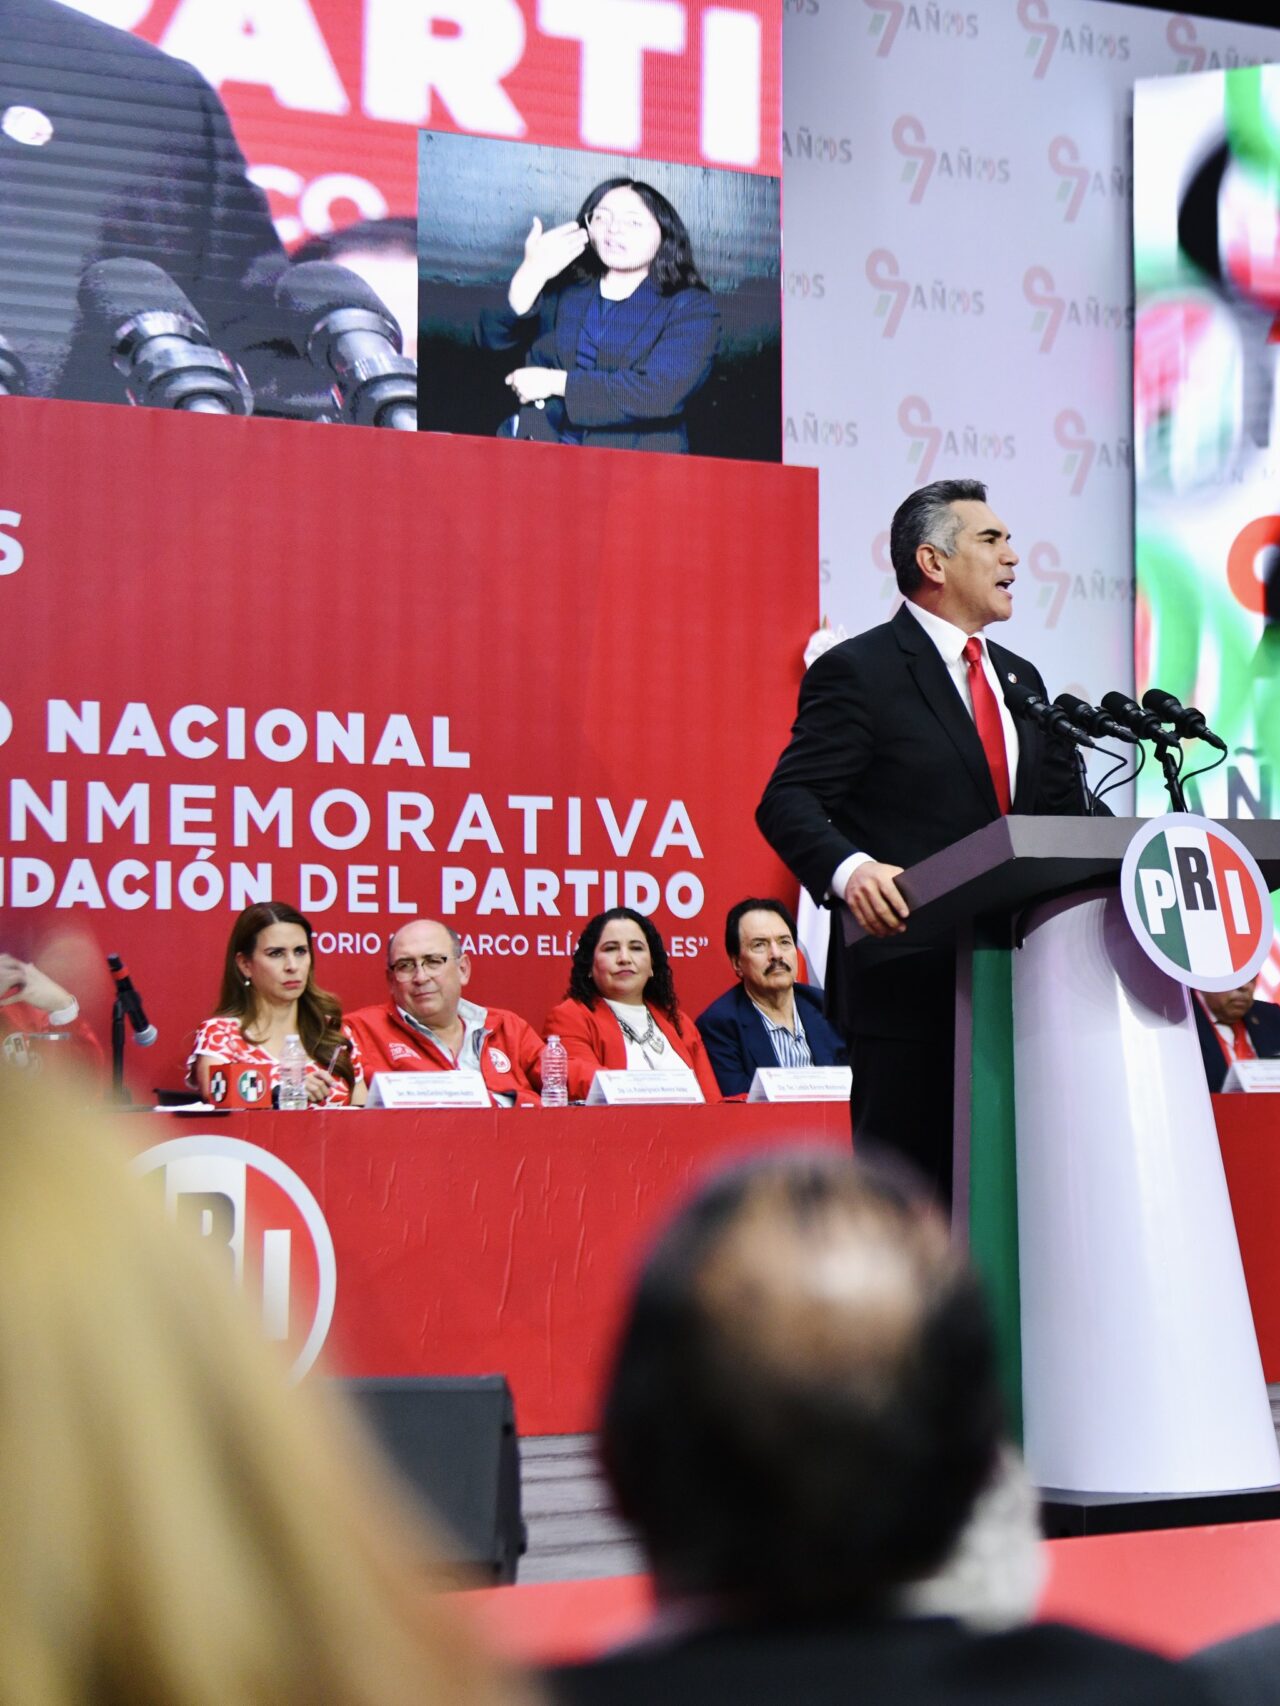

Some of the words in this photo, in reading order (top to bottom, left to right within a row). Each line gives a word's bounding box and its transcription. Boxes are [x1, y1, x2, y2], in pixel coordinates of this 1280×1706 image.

[113, 0, 763, 166] ARTI
[47, 698, 471, 769] NACIONAL
[10, 777, 705, 859] NMEMORATIVA
[0, 846, 273, 912] DACIÓN
[300, 862, 418, 914] DEL
[441, 867, 705, 920] PARTIDO
[1138, 846, 1251, 935] PRI
